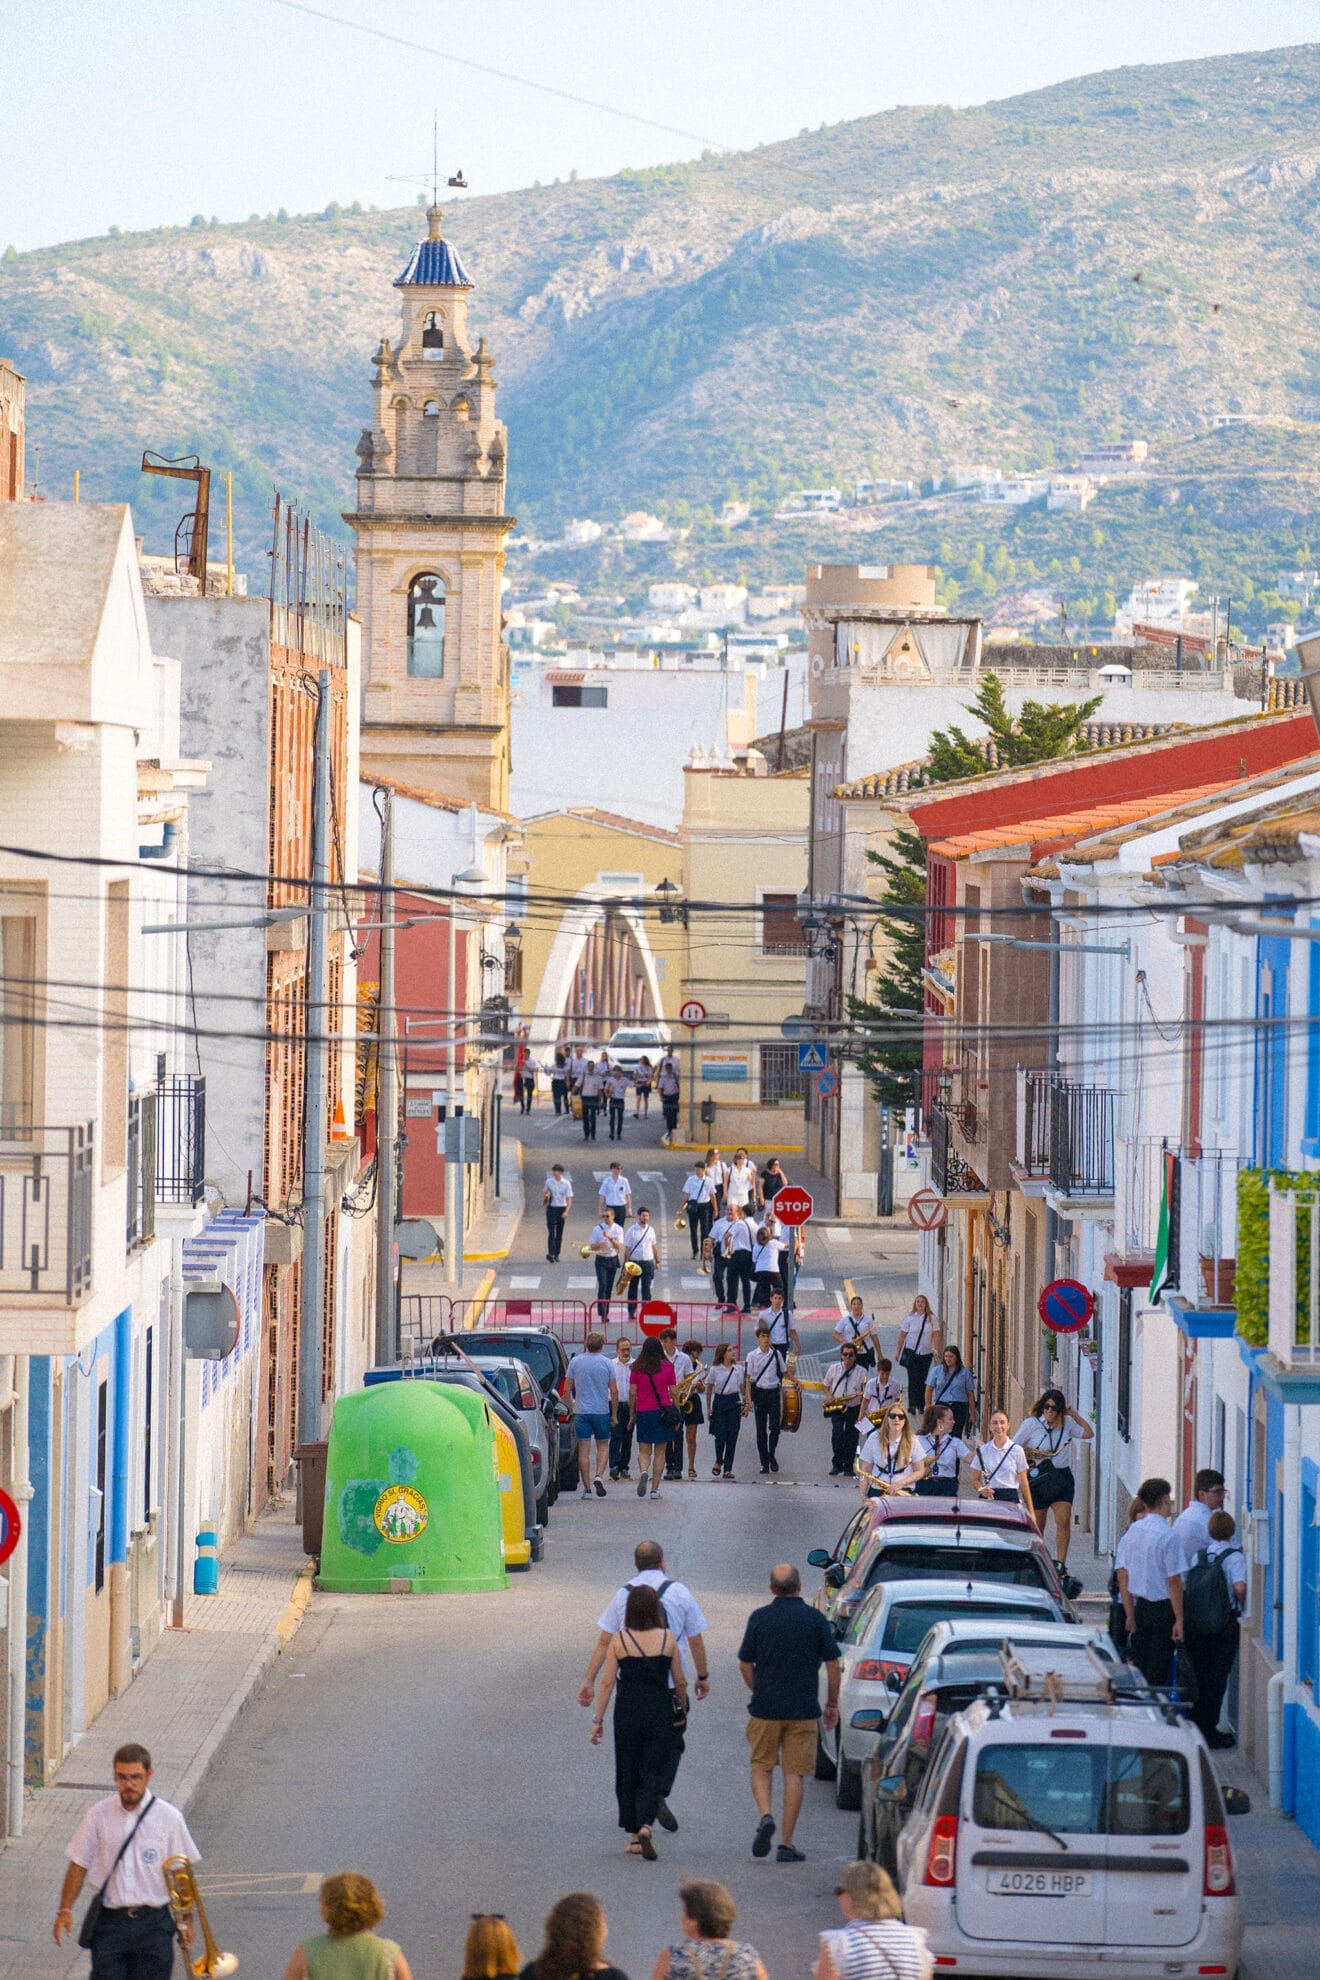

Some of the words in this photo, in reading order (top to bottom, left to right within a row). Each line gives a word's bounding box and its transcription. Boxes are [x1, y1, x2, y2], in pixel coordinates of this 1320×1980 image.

[776, 1201, 810, 1212] STOP
[375, 1494, 388, 1519] VIDRIO
[1000, 1874, 1047, 1891] 4026
[1051, 1875, 1086, 1892] HBP
